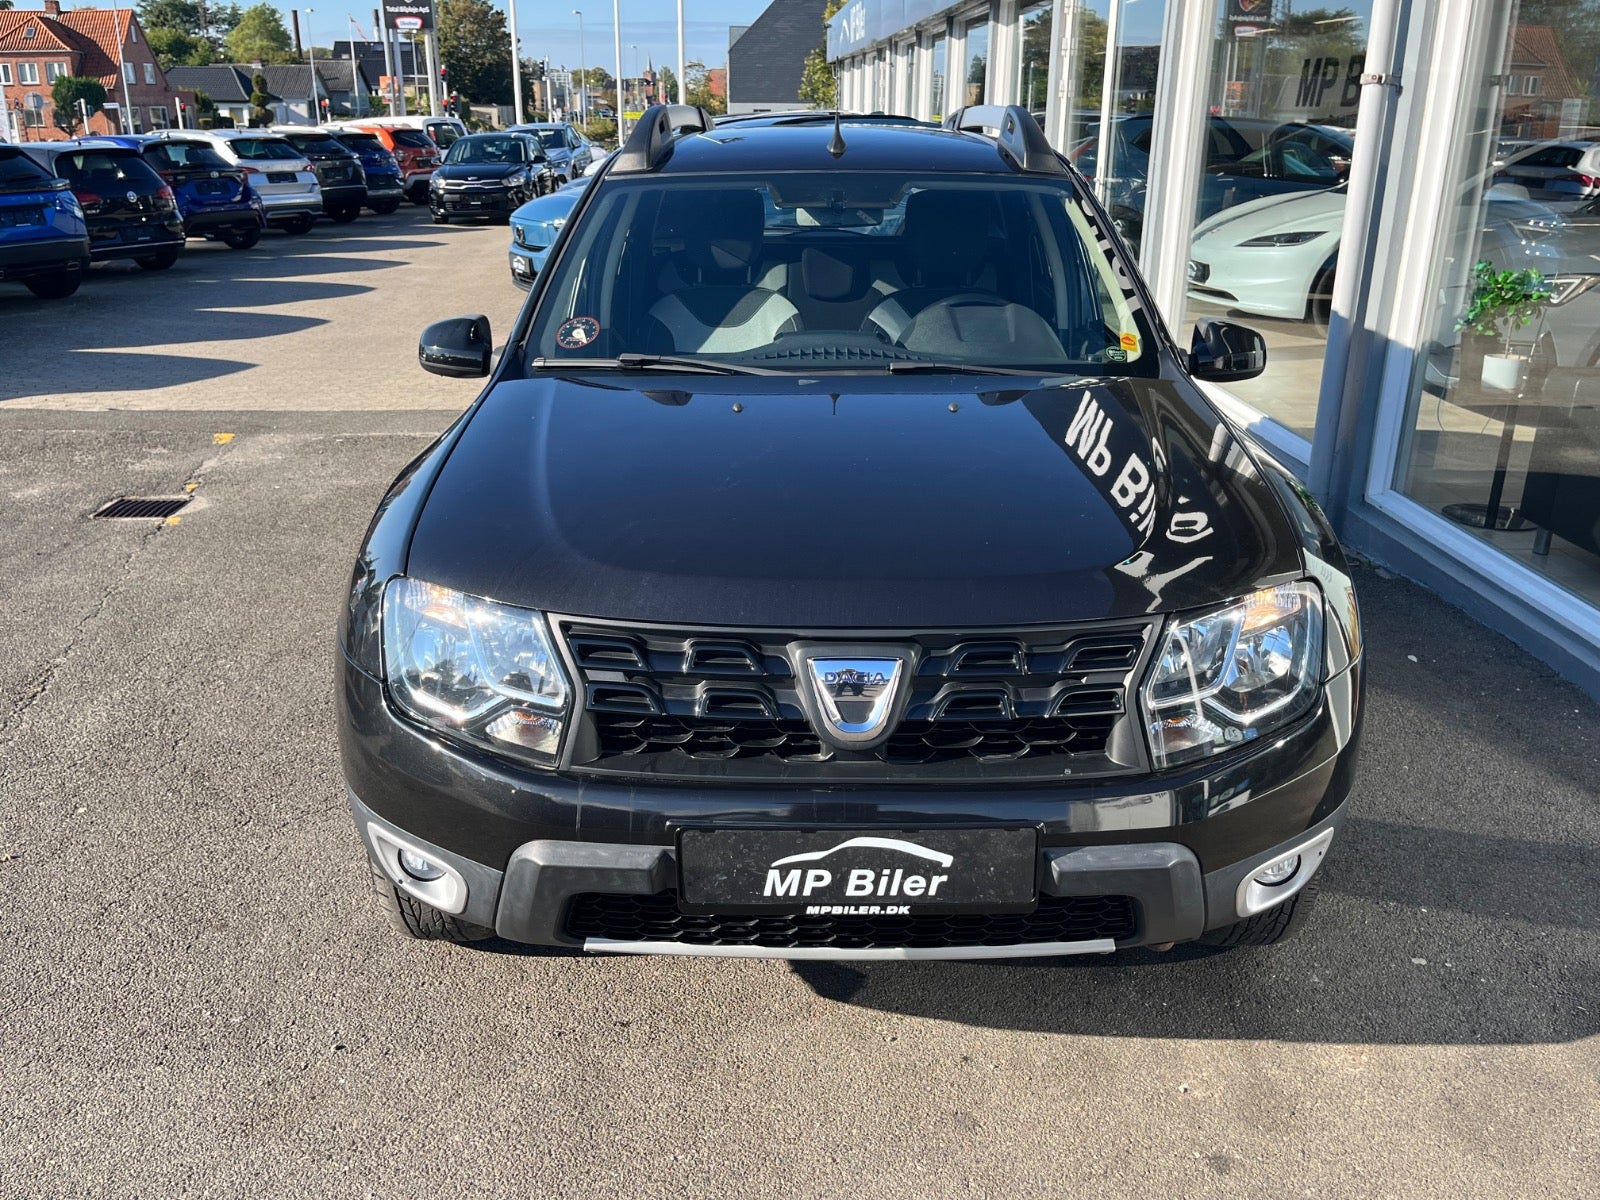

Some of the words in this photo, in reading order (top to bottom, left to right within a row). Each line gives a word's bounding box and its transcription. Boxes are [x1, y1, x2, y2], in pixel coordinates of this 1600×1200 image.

[1295, 57, 1339, 107] MP
[824, 671, 887, 685] DACIA
[763, 869, 832, 897] MP
[845, 868, 948, 897] Biler
[805, 905, 911, 916] MPBILER.DK
